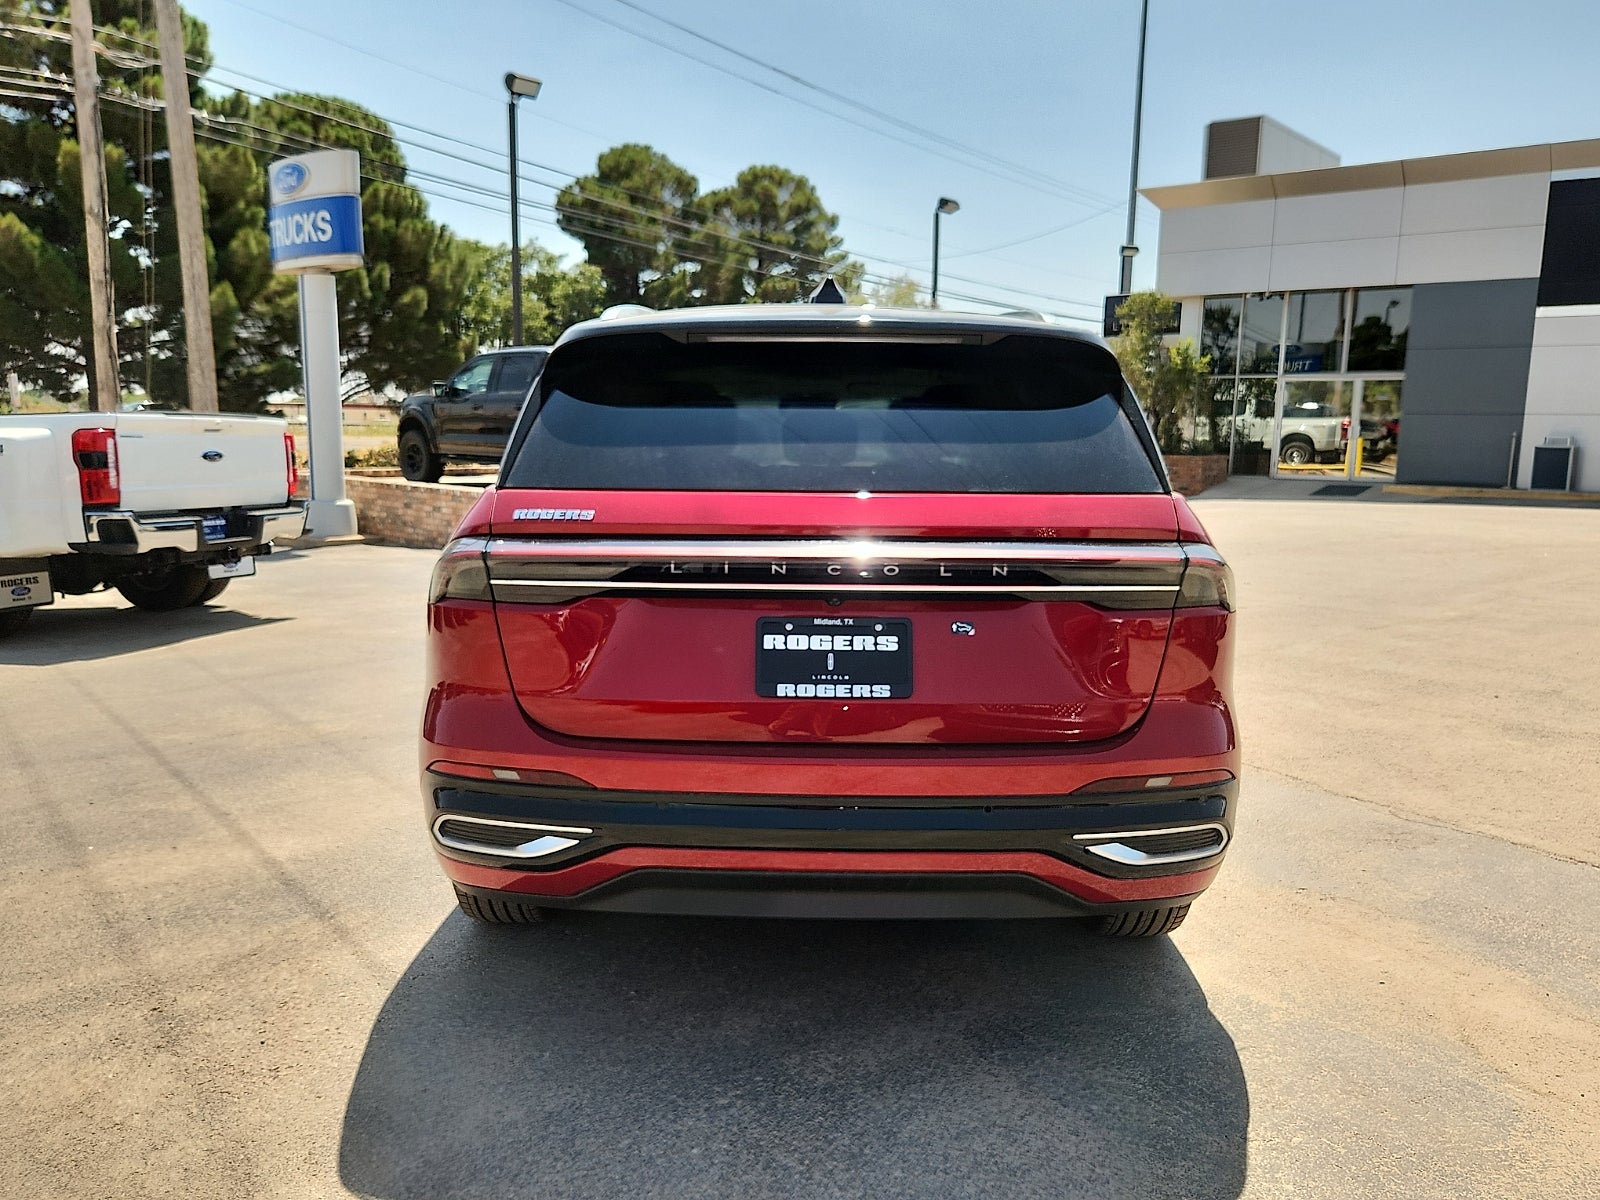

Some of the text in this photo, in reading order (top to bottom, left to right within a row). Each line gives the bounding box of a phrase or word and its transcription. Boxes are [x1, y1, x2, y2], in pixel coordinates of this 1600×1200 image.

[270, 209, 332, 248] TRUCKS
[513, 508, 595, 521] ROGERS
[670, 561, 1008, 577] LINCOLN
[843, 618, 854, 626] TX
[763, 634, 899, 651] ROGERS
[776, 683, 891, 698] ROGERS
